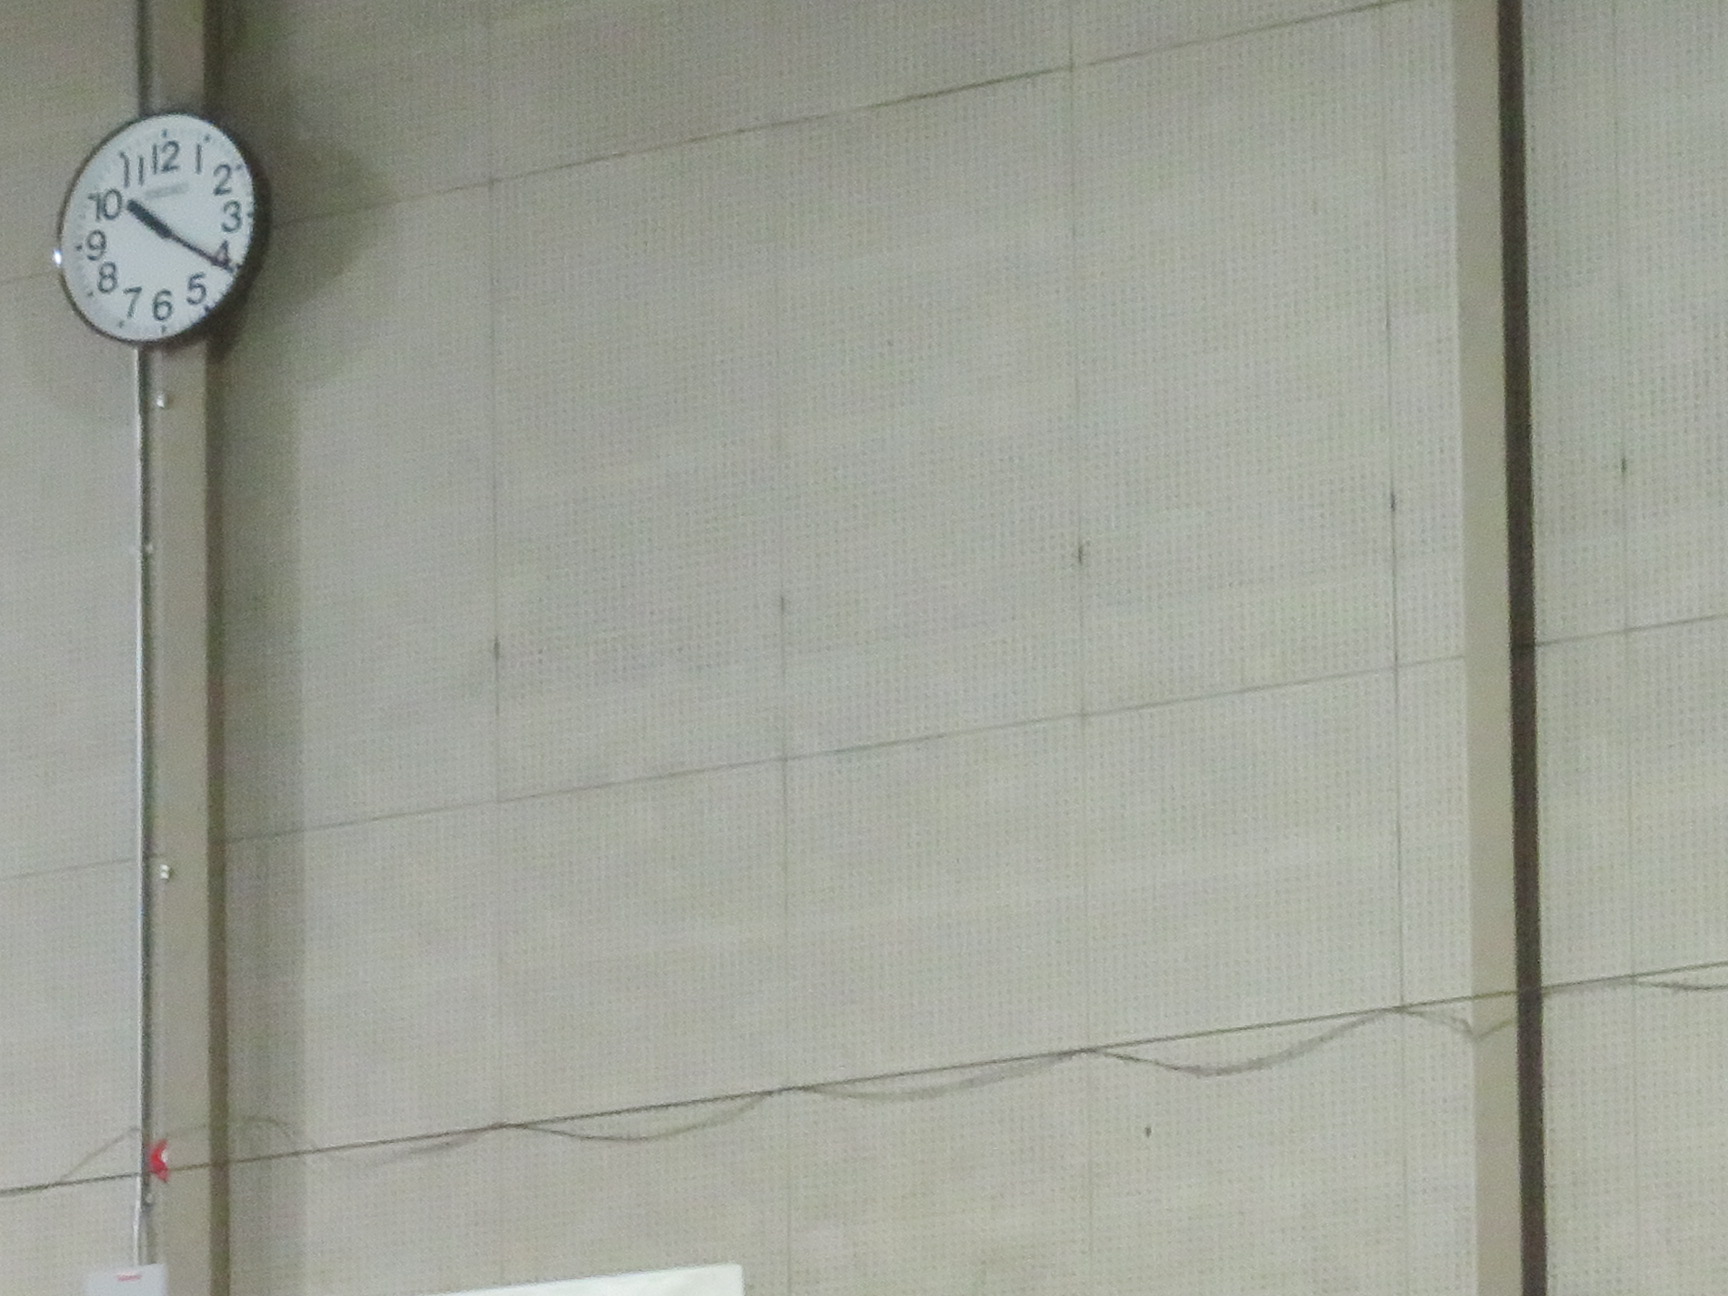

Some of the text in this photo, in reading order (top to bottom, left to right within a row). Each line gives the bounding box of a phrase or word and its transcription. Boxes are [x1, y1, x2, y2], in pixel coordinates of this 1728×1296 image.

[120, 152, 145, 188] 11
[152, 140, 180, 175] 12
[213, 164, 232, 196] 2
[89, 189, 123, 222] 10
[221, 201, 243, 233] 3
[86, 230, 107, 261] 9
[97, 262, 118, 294] 8
[187, 273, 207, 305] 5
[123, 286, 143, 318] 7
[152, 290, 173, 321] 6
